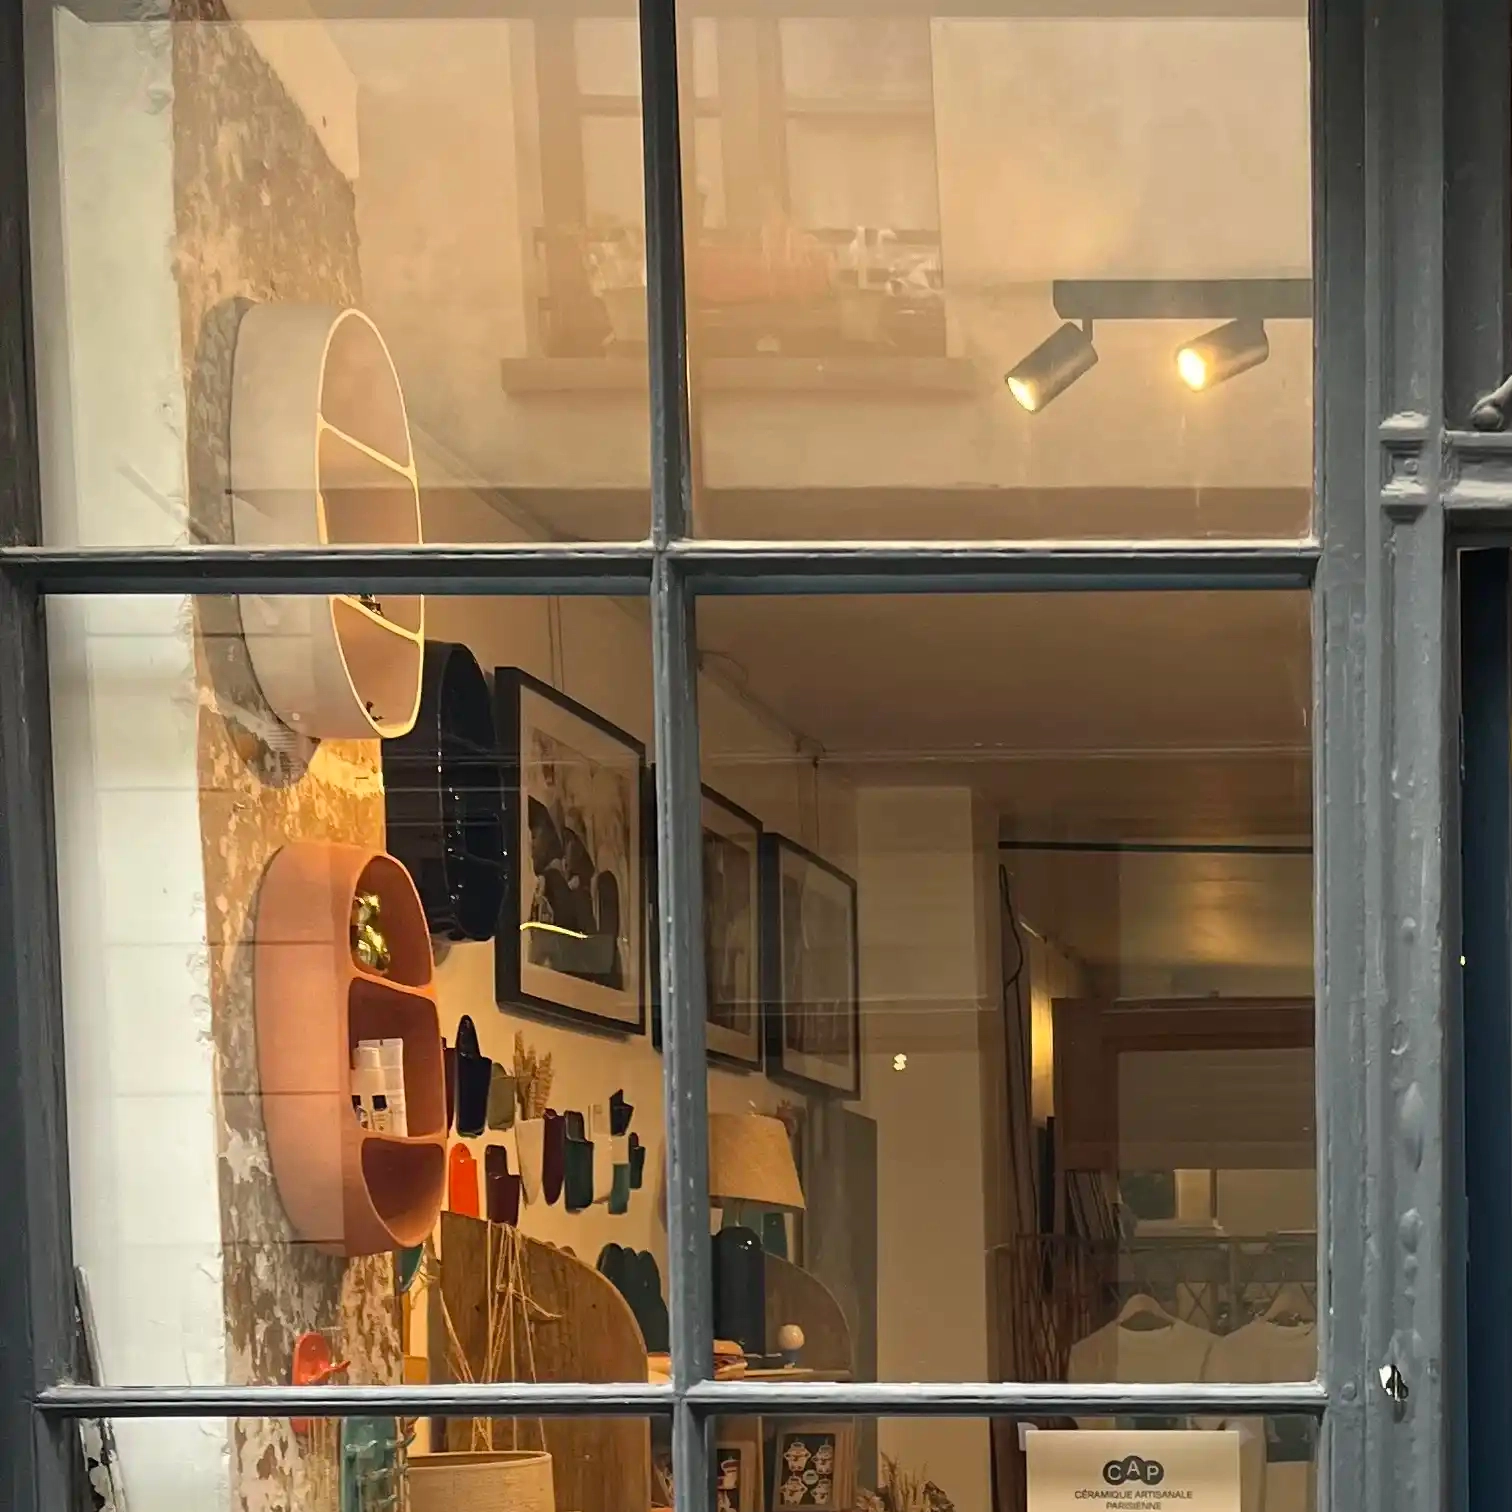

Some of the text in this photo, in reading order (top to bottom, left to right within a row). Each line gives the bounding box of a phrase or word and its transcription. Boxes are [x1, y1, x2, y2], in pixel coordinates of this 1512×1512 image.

[1107, 1459, 1160, 1481] CAP
[1074, 1488, 1193, 1500] CÉRAMIQUE ARTISANALE
[1106, 1502, 1161, 1510] PARISIENNE
